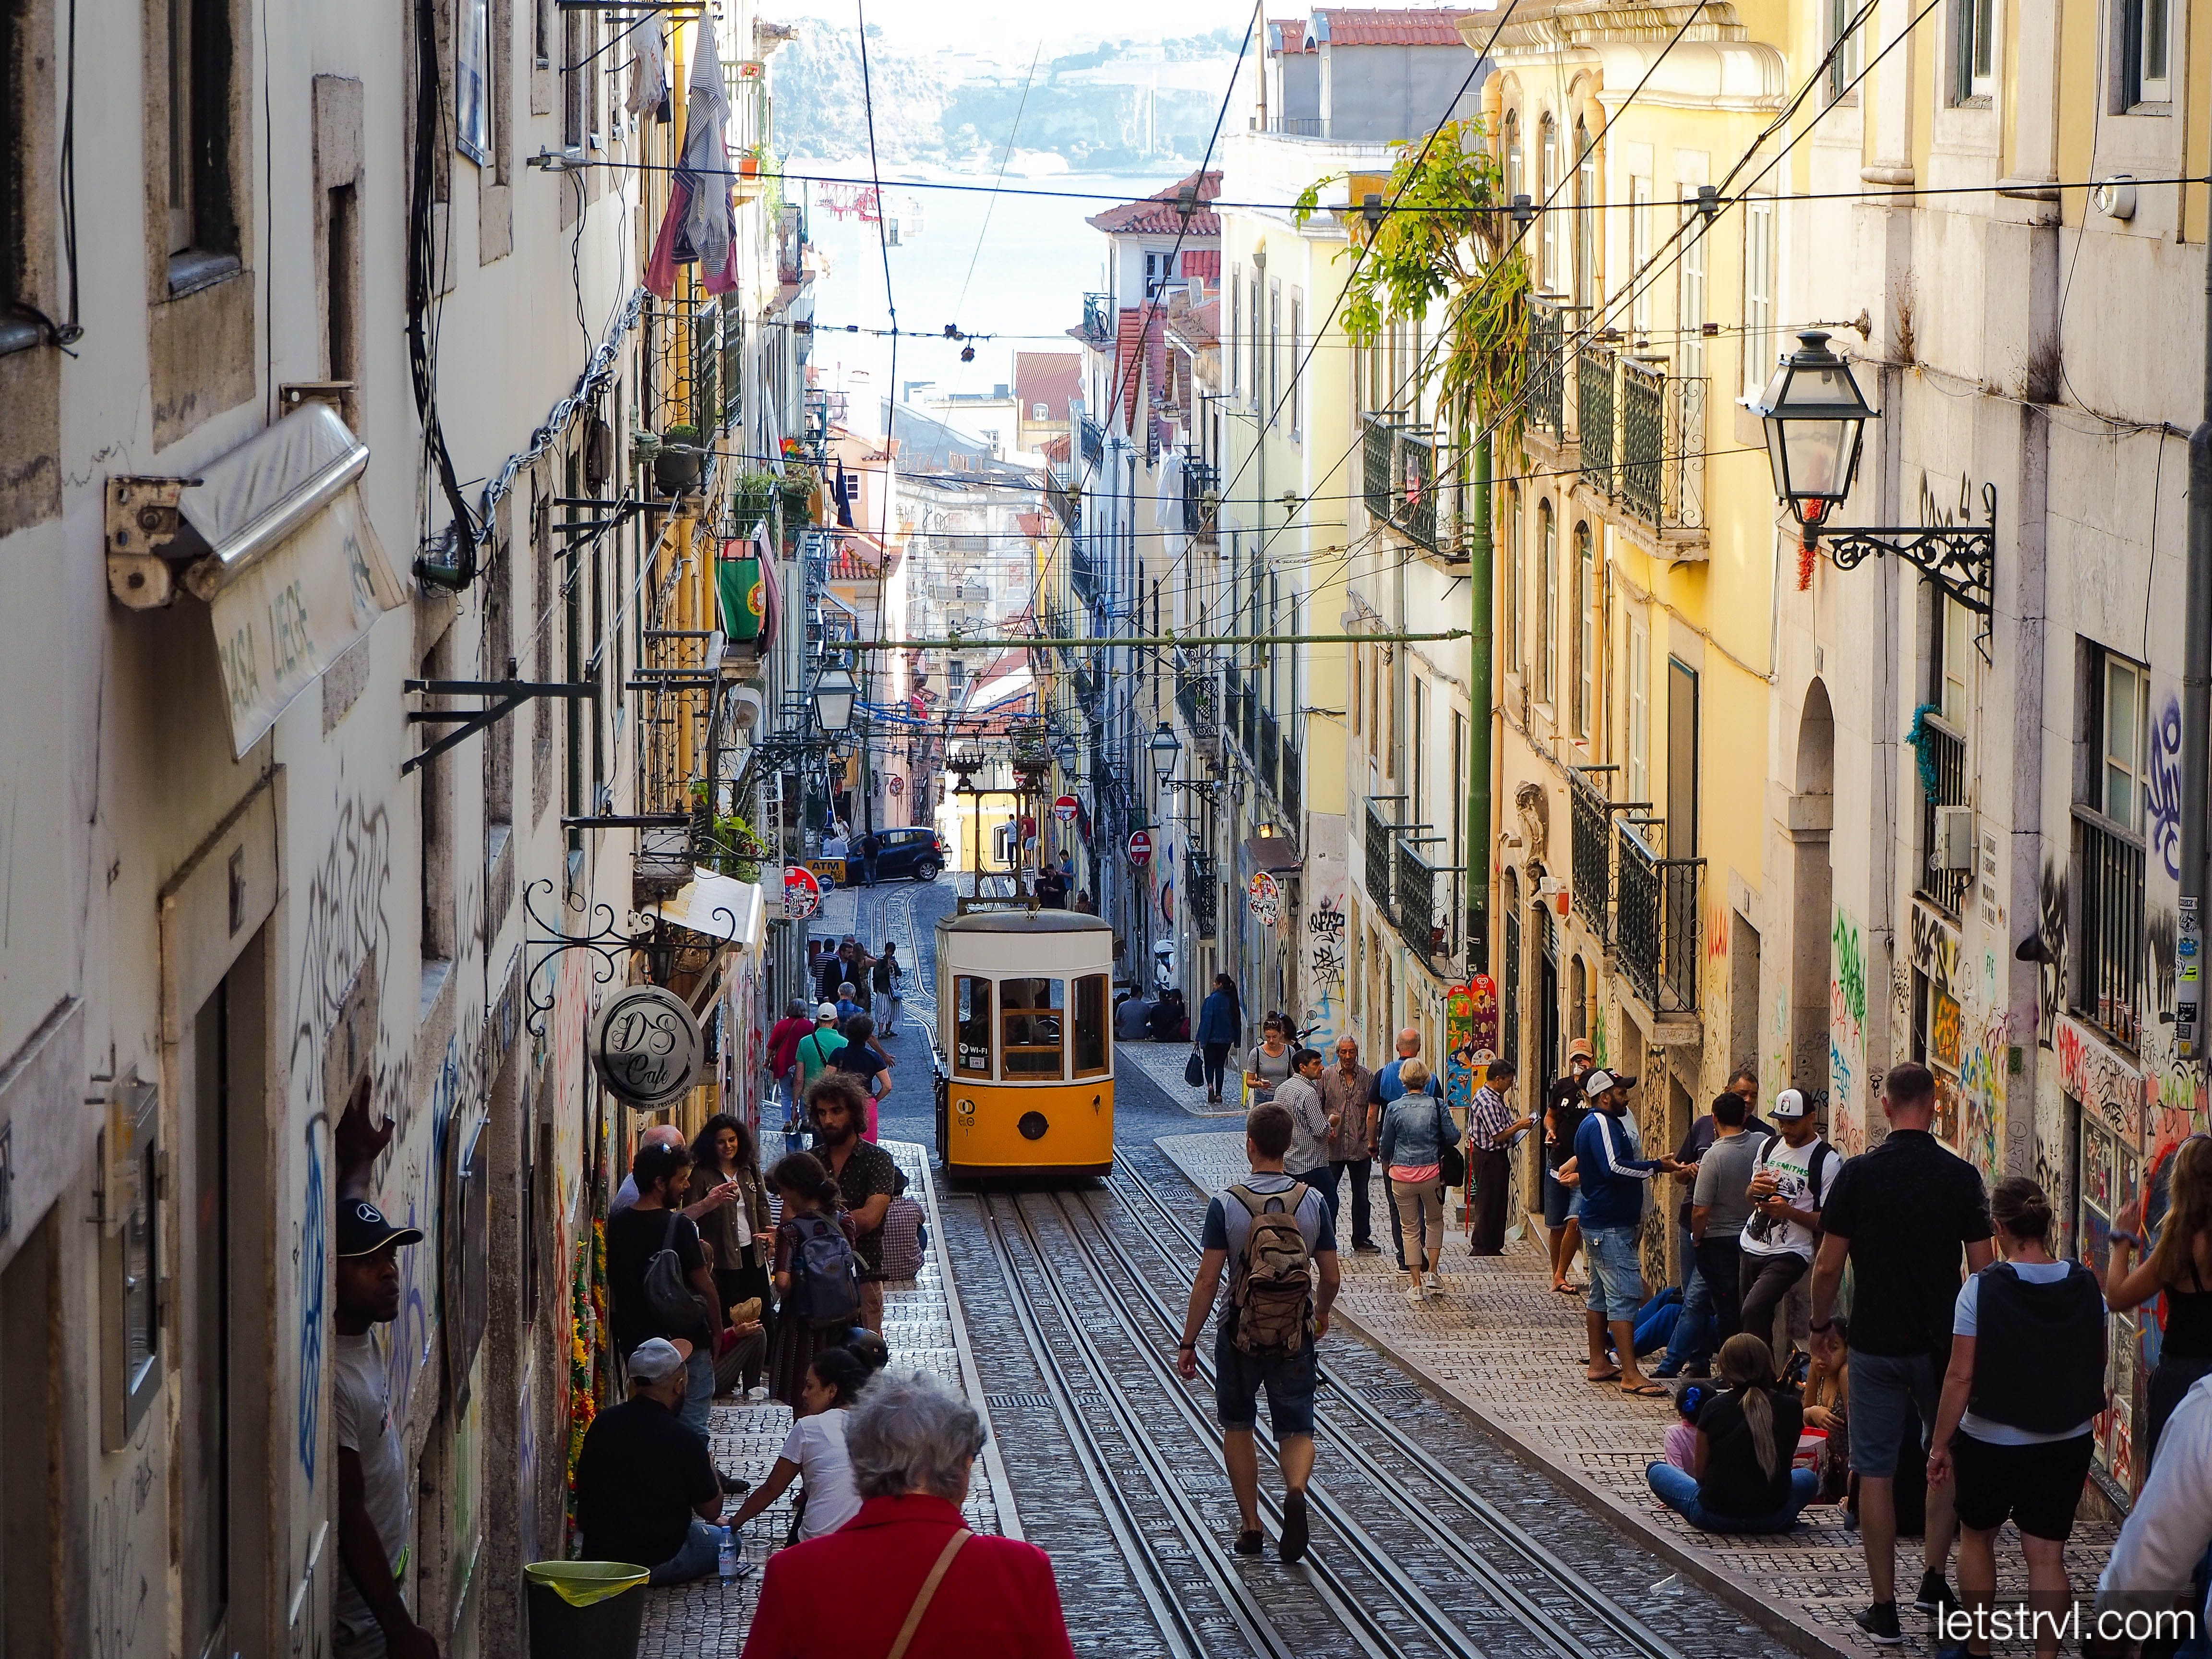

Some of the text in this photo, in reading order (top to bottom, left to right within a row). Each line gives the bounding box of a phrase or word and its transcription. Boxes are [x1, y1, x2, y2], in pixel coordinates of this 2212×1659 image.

[812, 862, 839, 870] ATM
[612, 1011, 677, 1056] DS
[970, 1046, 987, 1054] WI-FI
